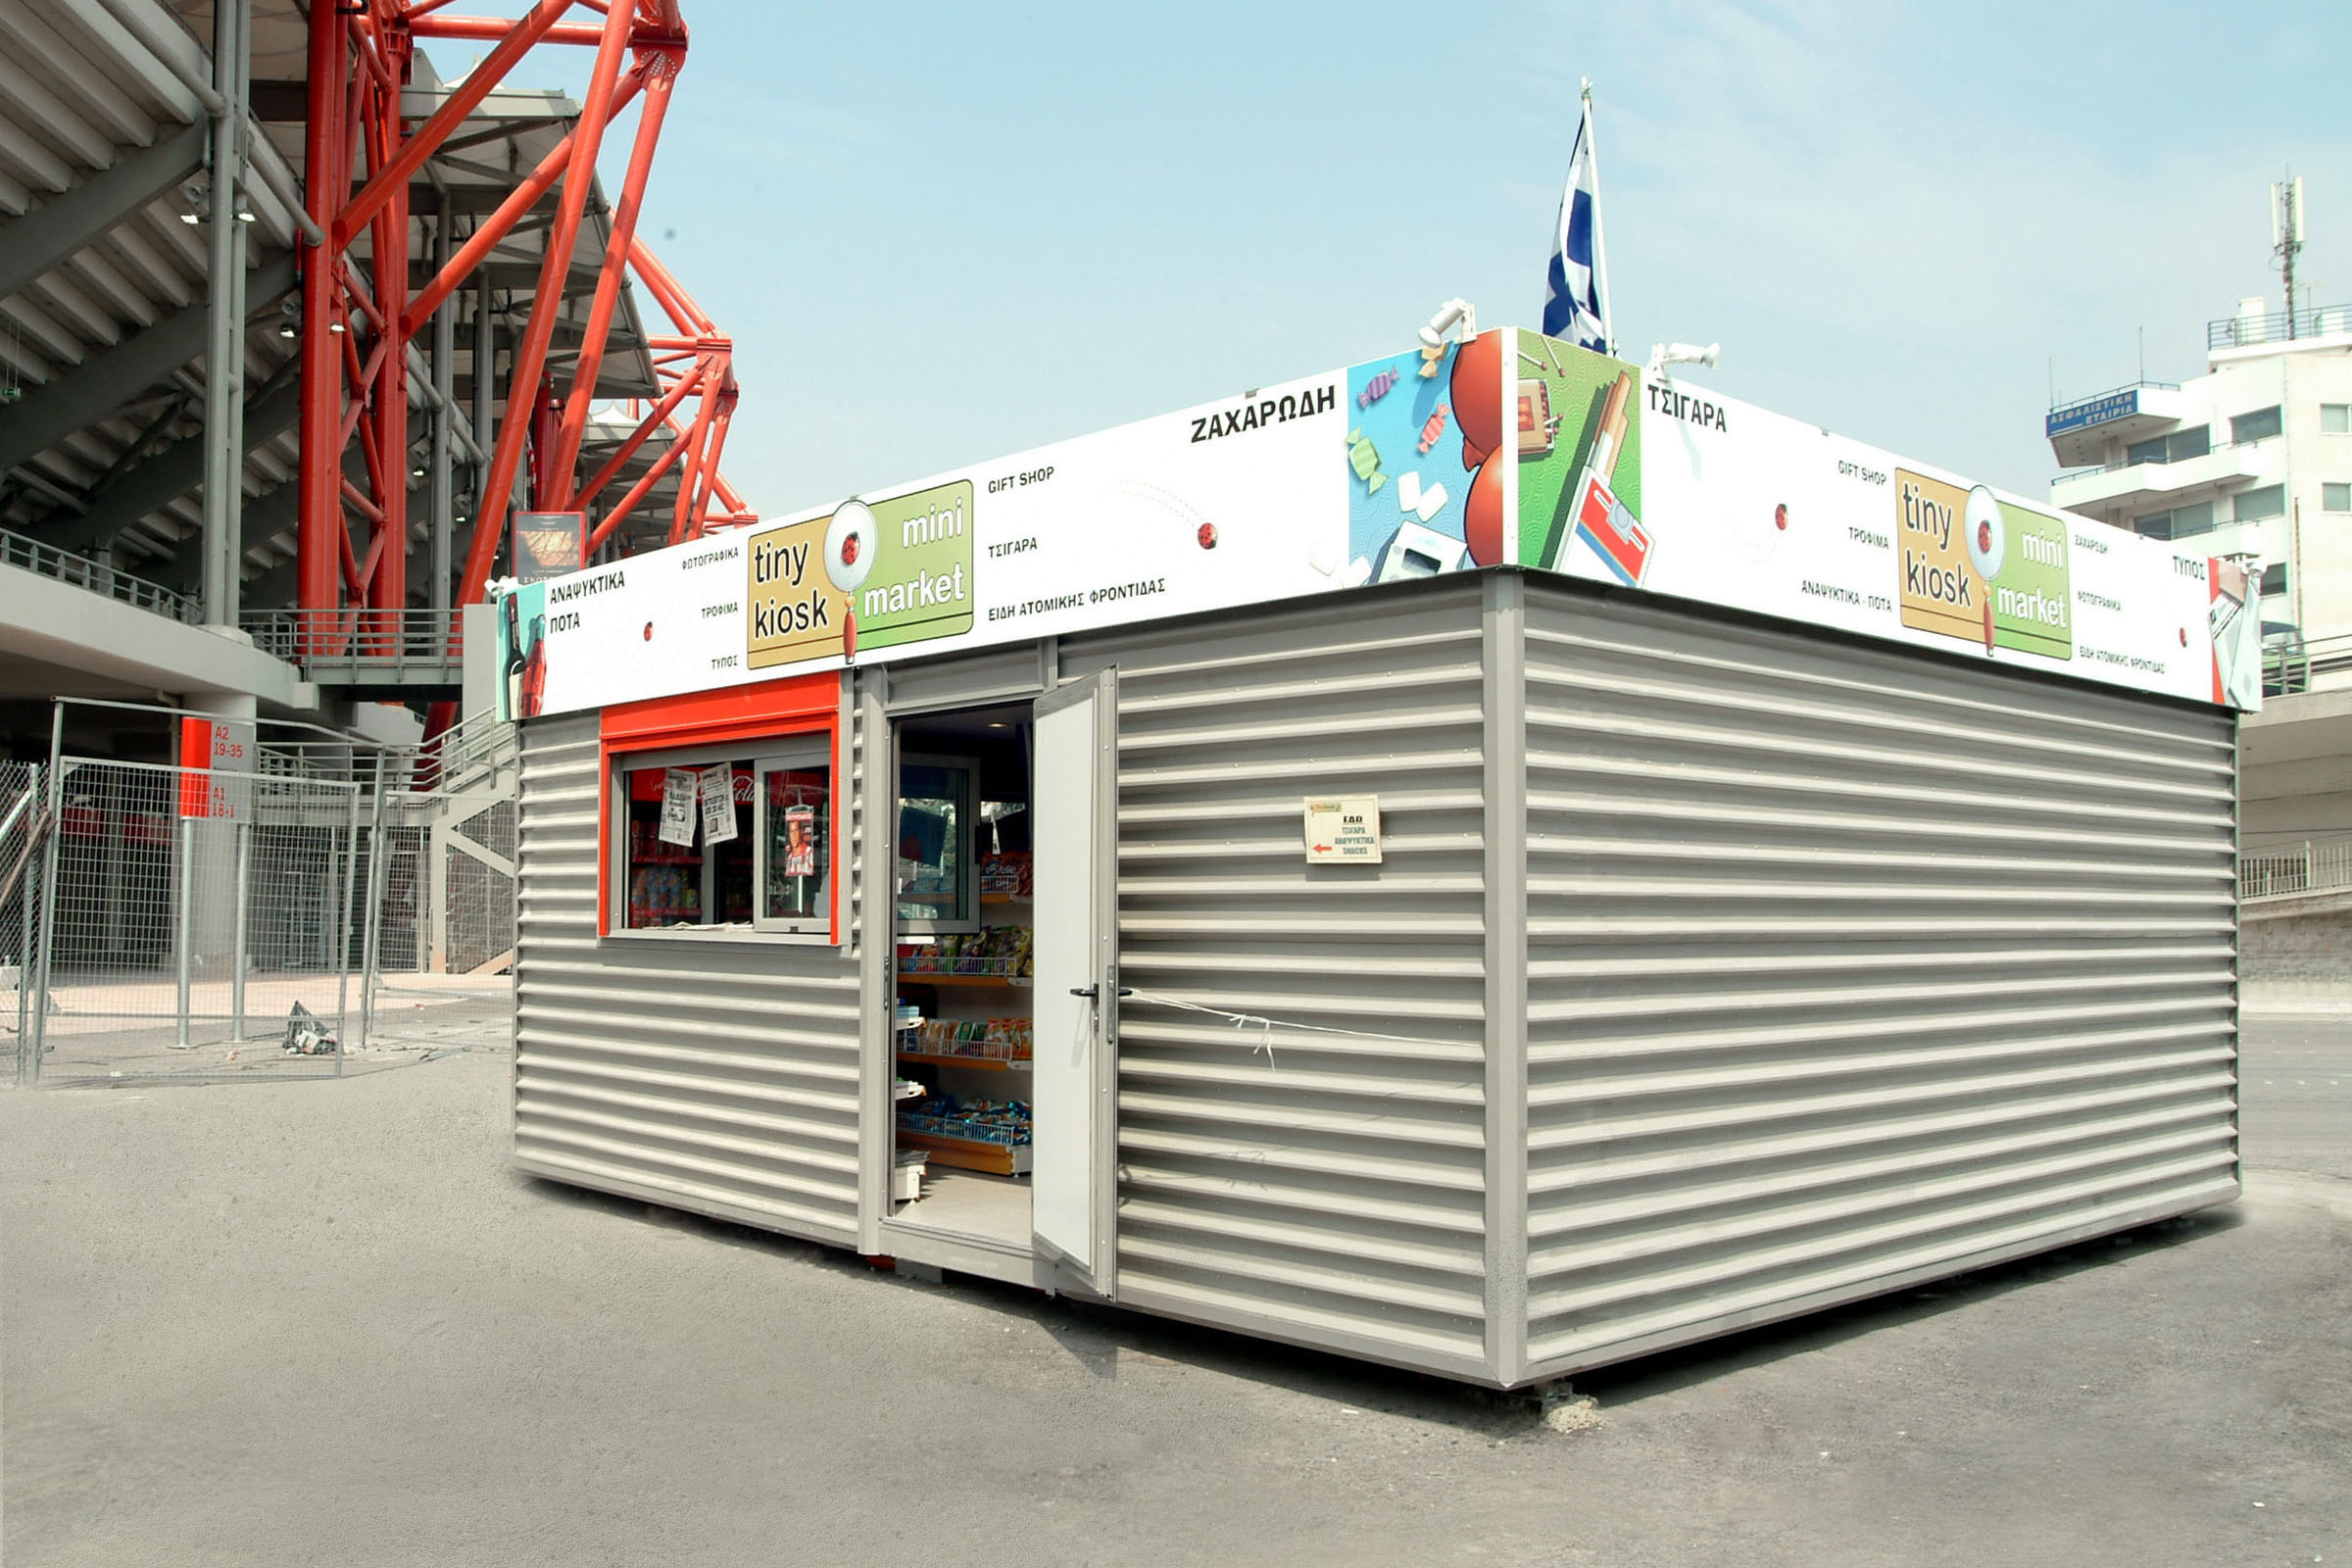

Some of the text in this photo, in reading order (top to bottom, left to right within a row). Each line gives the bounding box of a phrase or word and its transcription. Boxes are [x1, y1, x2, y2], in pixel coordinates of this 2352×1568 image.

[1191, 384, 1335, 444] ΖΑΧΑΡΩΔΗ
[1647, 383, 1727, 432] ΤΣΙΓΑΡΑ
[2050, 392, 2133, 424] ΑΣΦΑΛΙΣΤΙΚΗ
[2084, 405, 2133, 424] ΕΤΑΙΡΙΑ
[988, 466, 1054, 494] GIFT SHOP
[1838, 460, 1886, 486] GIFT SHOP
[903, 497, 963, 549] mini
[1903, 483, 1951, 550] tiny
[988, 537, 1038, 559] ΤΣΙΓΑΡΑ
[1848, 526, 1888, 549] ΤΡΟΦΙΜΑ
[2022, 528, 2063, 568] mini
[682, 546, 739, 570] ΦΩΤΟΓΡΑΦΙΚΑ
[755, 542, 808, 586] tiny
[2172, 555, 2206, 581] ΤΥΠΟΣ
[550, 570, 625, 605] ΑΝΑΨΥΚΤΙΚΑ
[864, 562, 965, 616] market
[1907, 550, 1971, 606] kiosk
[701, 602, 739, 618] ΤΡΟΦΙΜΑ
[988, 577, 1165, 621] ΕΙΔΗ ΑΤΟΜΙΚΗΣ ΦΡΟΝΤΙΔΑΣ
[1801, 579, 1860, 605] ΑΝΑΨΥΚΤΙΚΑ
[1868, 596, 1892, 612] ΠΟΤΑ
[1997, 585, 2067, 628] market
[550, 612, 580, 634] ΠΟΤΑ
[755, 589, 827, 639] kiosk
[710, 655, 738, 669] ΤΥΠΟΣ
[215, 725, 229, 741] A2
[214, 742, 244, 759] 19-35
[213, 786, 225, 801] A1
[213, 803, 235, 818] 18-1
